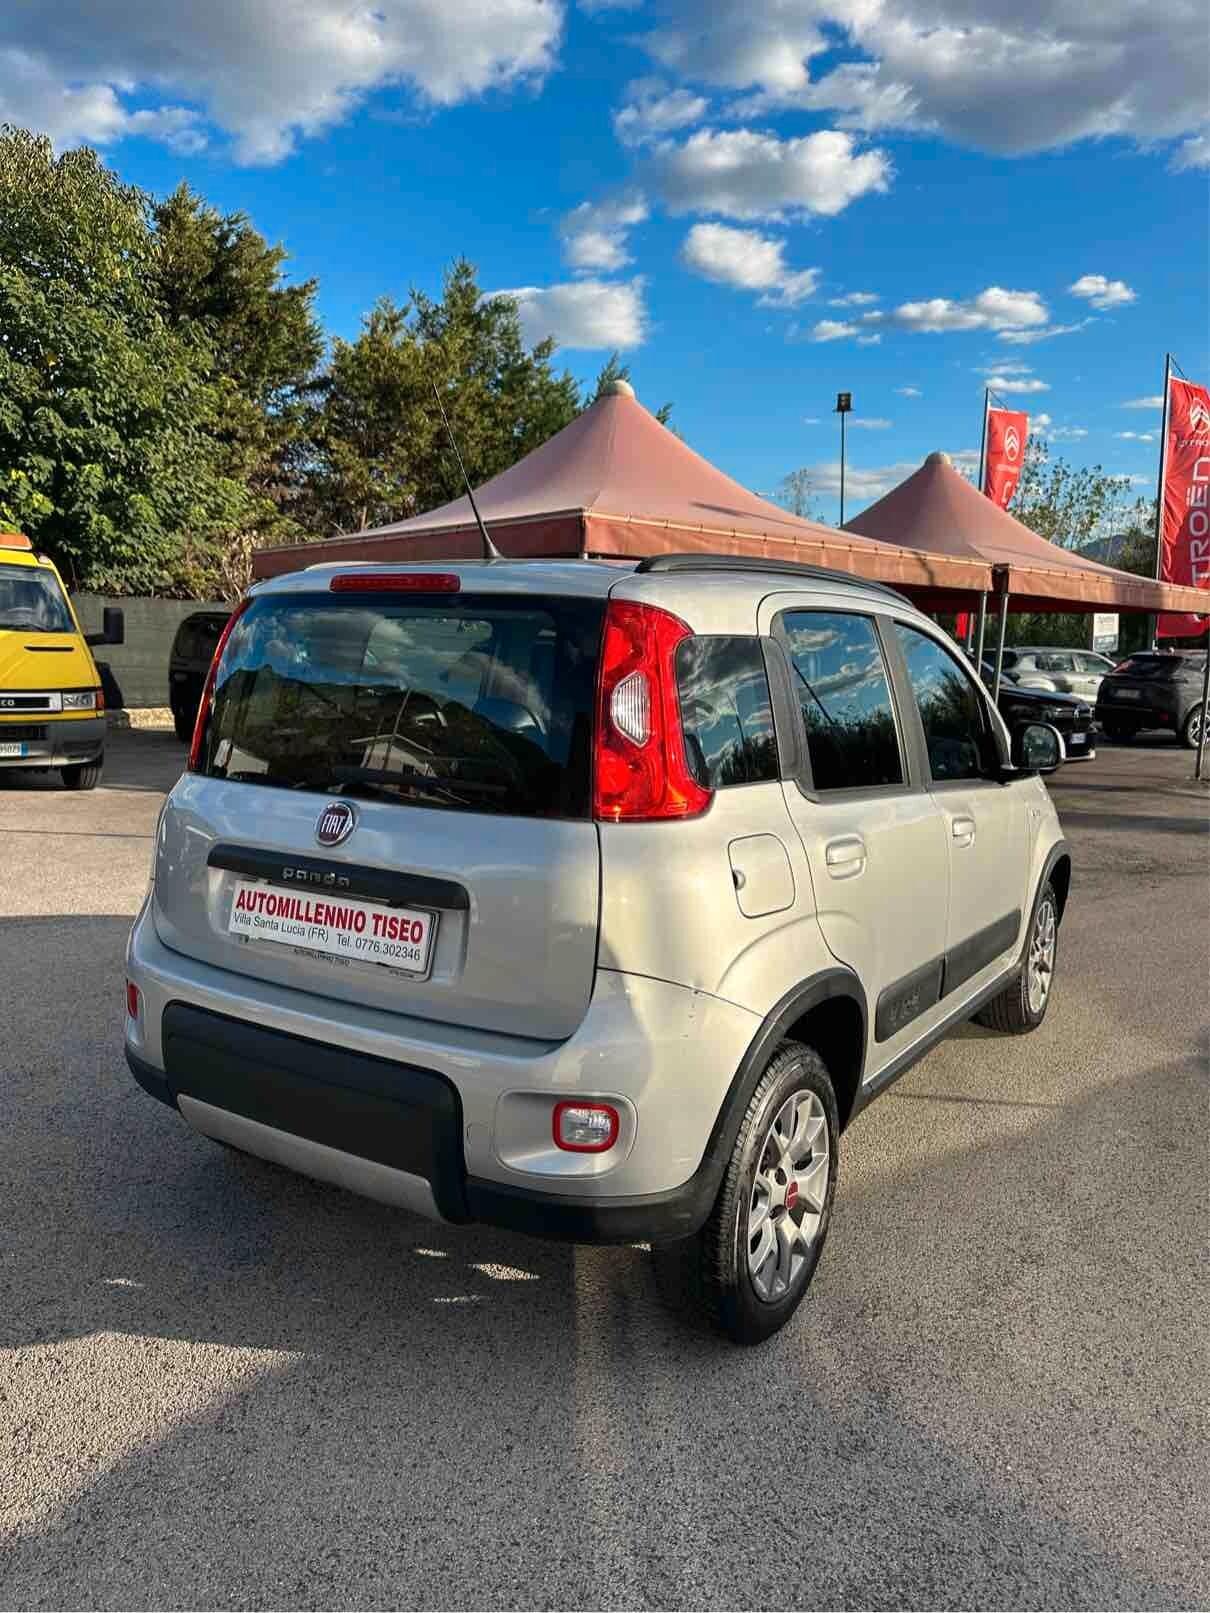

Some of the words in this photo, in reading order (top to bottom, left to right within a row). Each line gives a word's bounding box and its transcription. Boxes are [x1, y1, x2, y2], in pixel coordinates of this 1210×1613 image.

[1186, 457, 1210, 588] TROËN
[320, 813, 346, 833] FIAT
[282, 867, 350, 887] panda
[234, 912, 252, 926] Villa
[254, 916, 279, 931] Santa
[281, 922, 306, 937] Lucia
[308, 927, 330, 943] (FR)
[336, 933, 352, 947] Tel.
[355, 939, 421, 962] 0776.302346
[236, 889, 366, 933] AUTOMILLENNIO
[372, 913, 423, 943] TISEO
